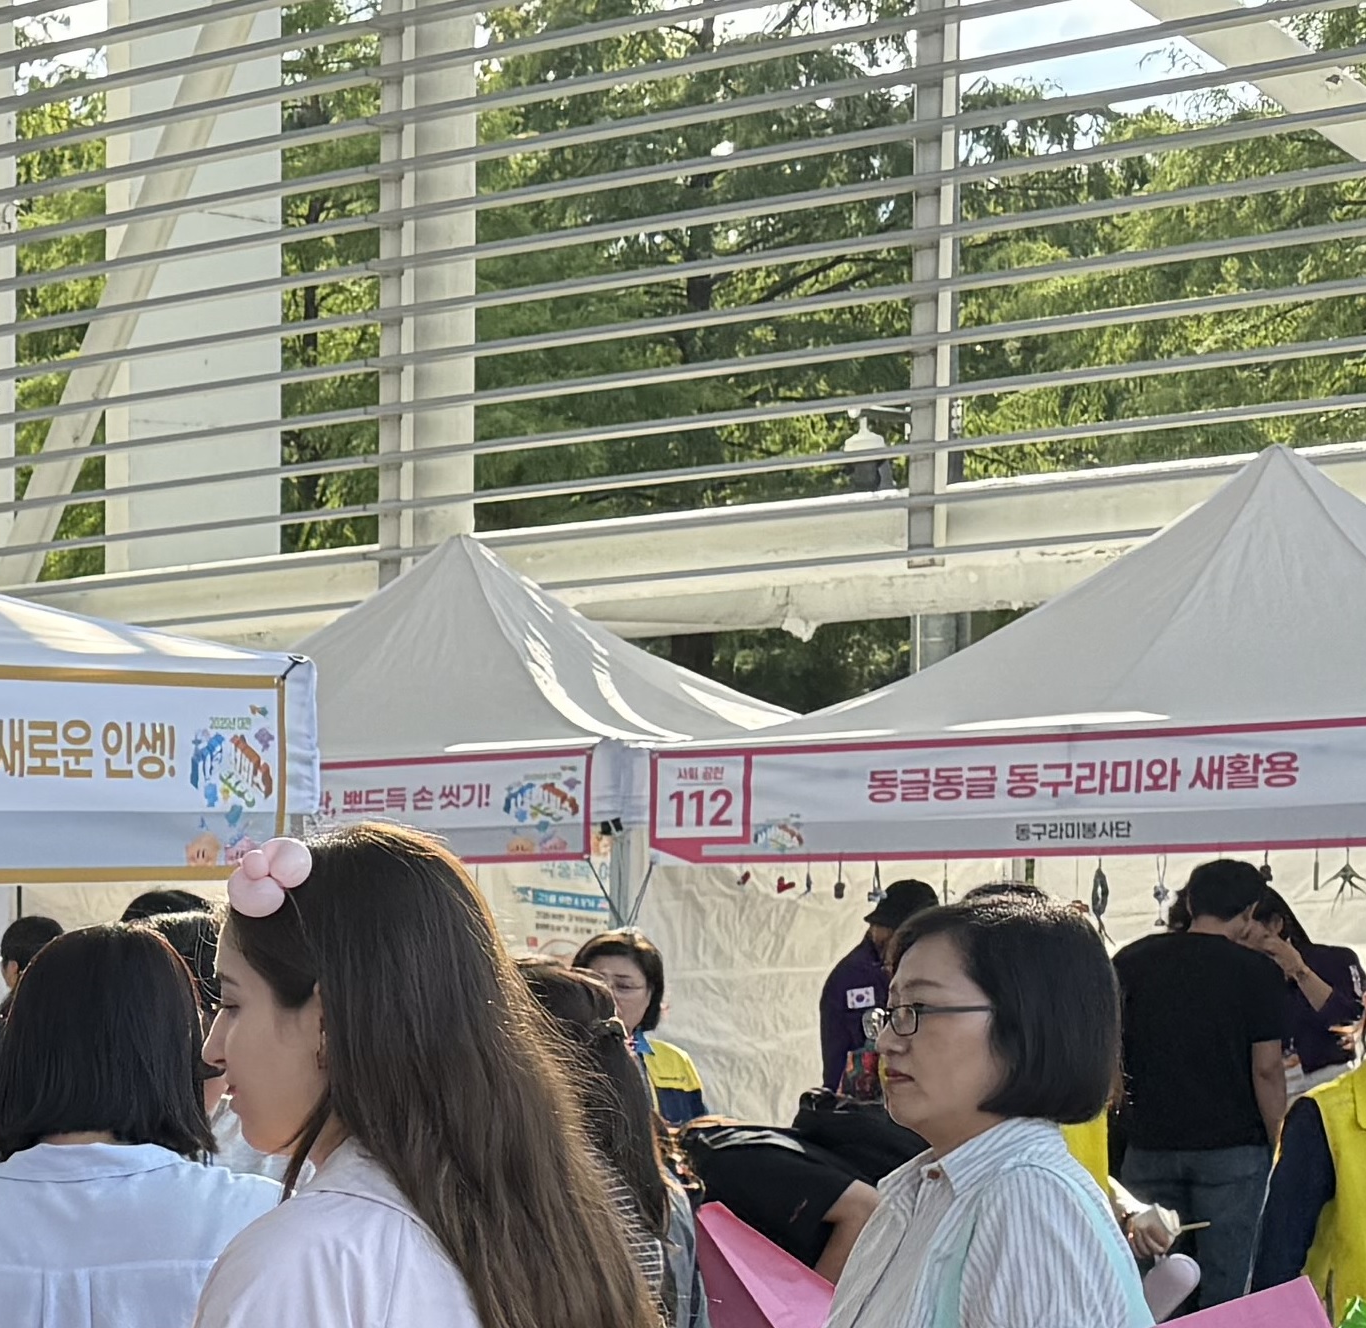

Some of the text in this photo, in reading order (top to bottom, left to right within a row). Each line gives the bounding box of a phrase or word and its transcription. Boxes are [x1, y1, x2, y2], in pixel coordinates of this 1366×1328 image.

[100, 719, 177, 780] 인생!
[867, 750, 1300, 804] 동글동글 동구라미와 새활용
[342, 786, 407, 815] 뽀드득
[413, 785, 434, 812] 손
[439, 782, 492, 811] 씻기!
[669, 788, 734, 828] 112
[1015, 820, 1133, 841] 동구라미봉사단
